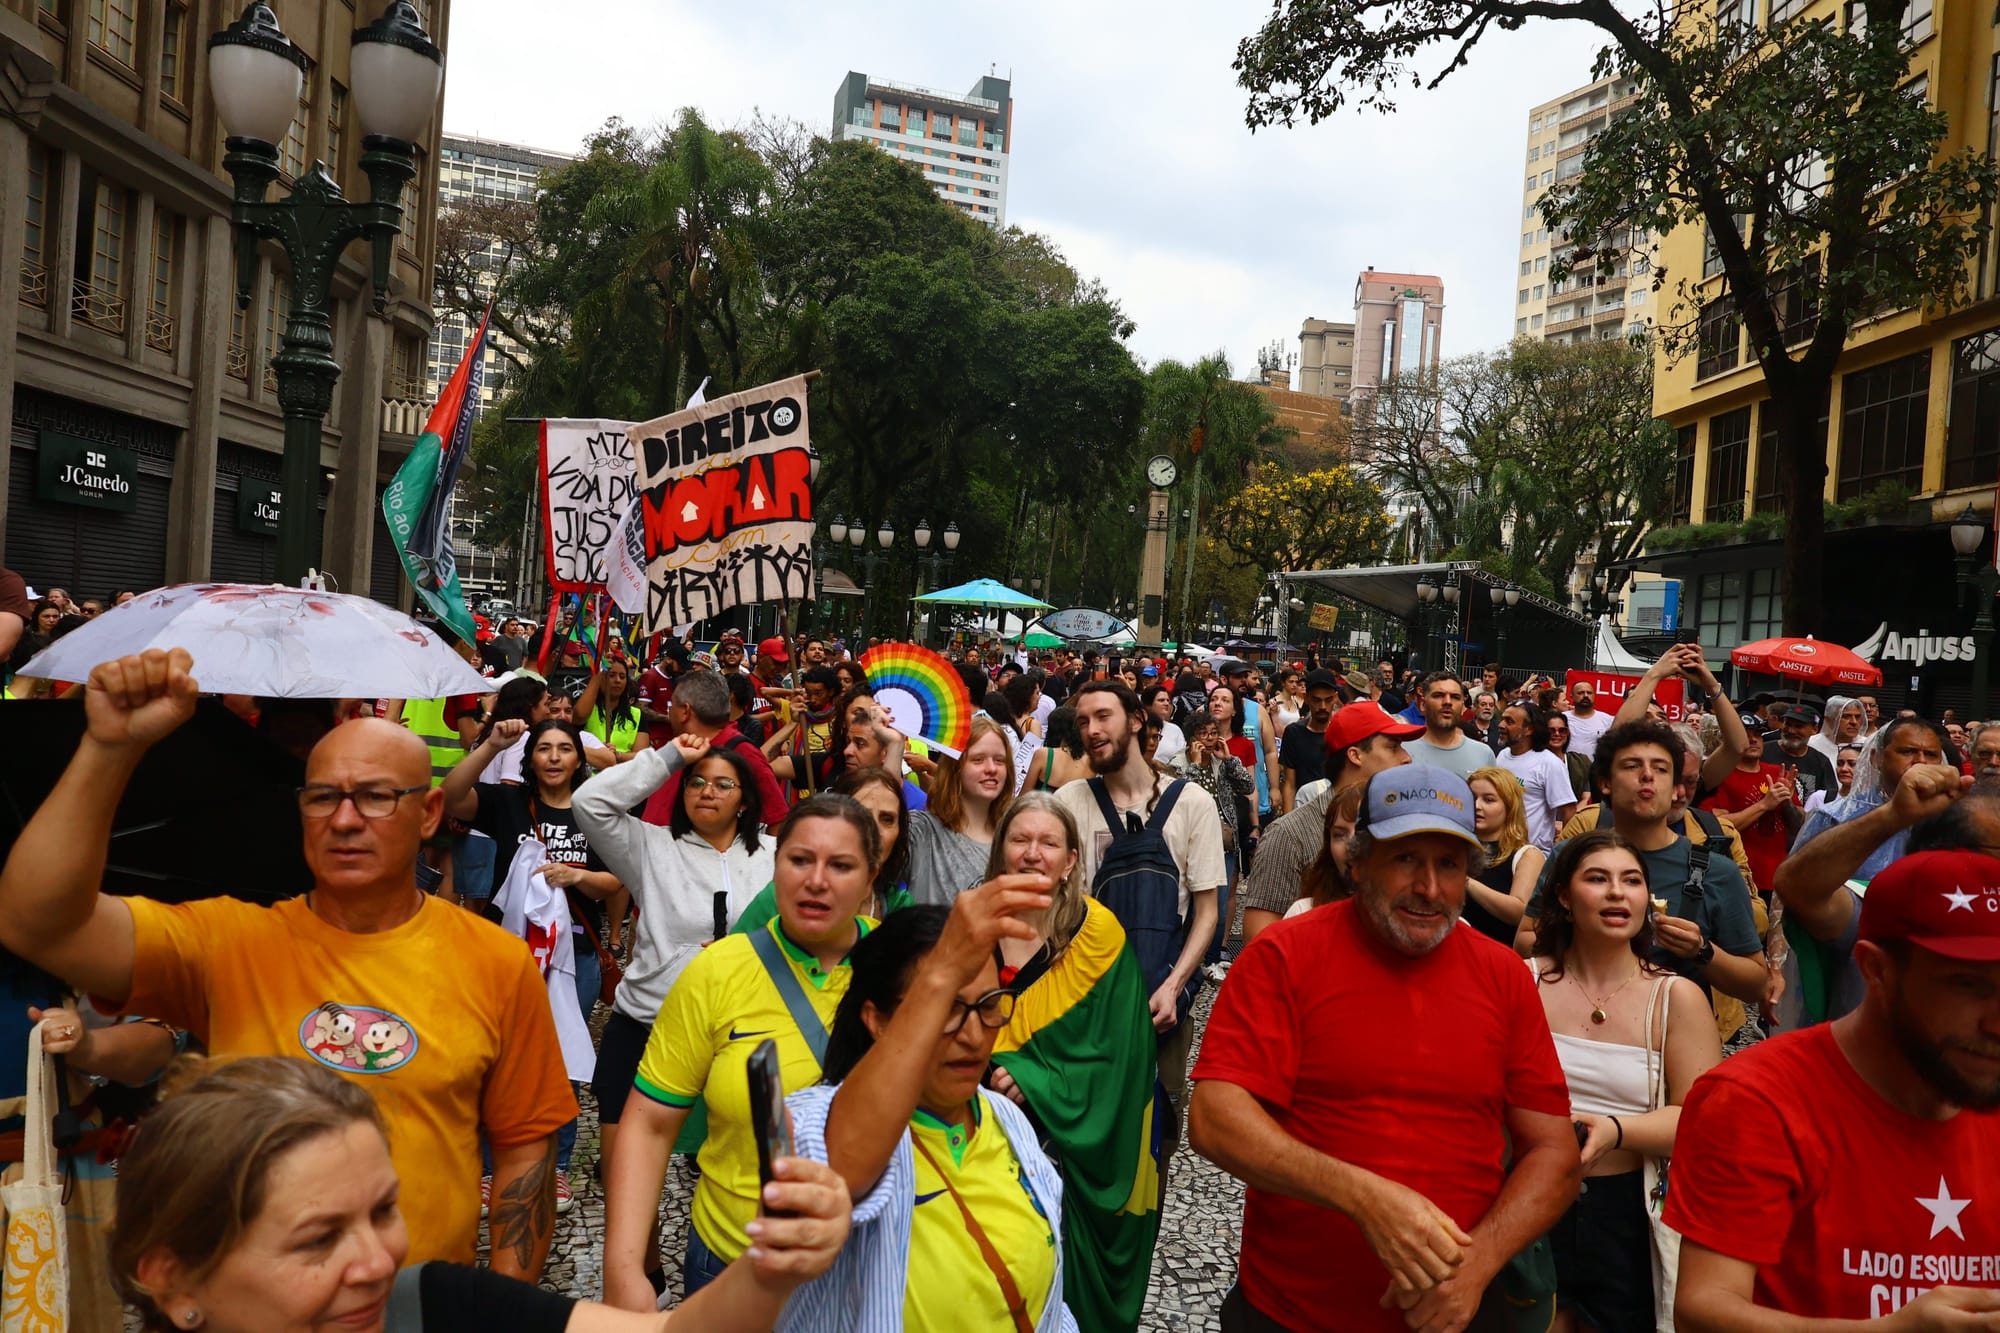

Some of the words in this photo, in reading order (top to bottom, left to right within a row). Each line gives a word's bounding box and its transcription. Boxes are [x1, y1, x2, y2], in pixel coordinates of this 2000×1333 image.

[60, 464, 129, 494] JCanedo
[389, 480, 405, 510] Rio
[640, 447, 813, 563] MORAR
[393, 513, 411, 536] ao
[1881, 628, 1977, 668] Anjuss
[1779, 660, 1814, 674] AMSTEL
[1838, 670, 1867, 681] AMSTEL
[1662, 704, 1680, 720] 13
[1843, 1247, 1904, 1279] LADO
